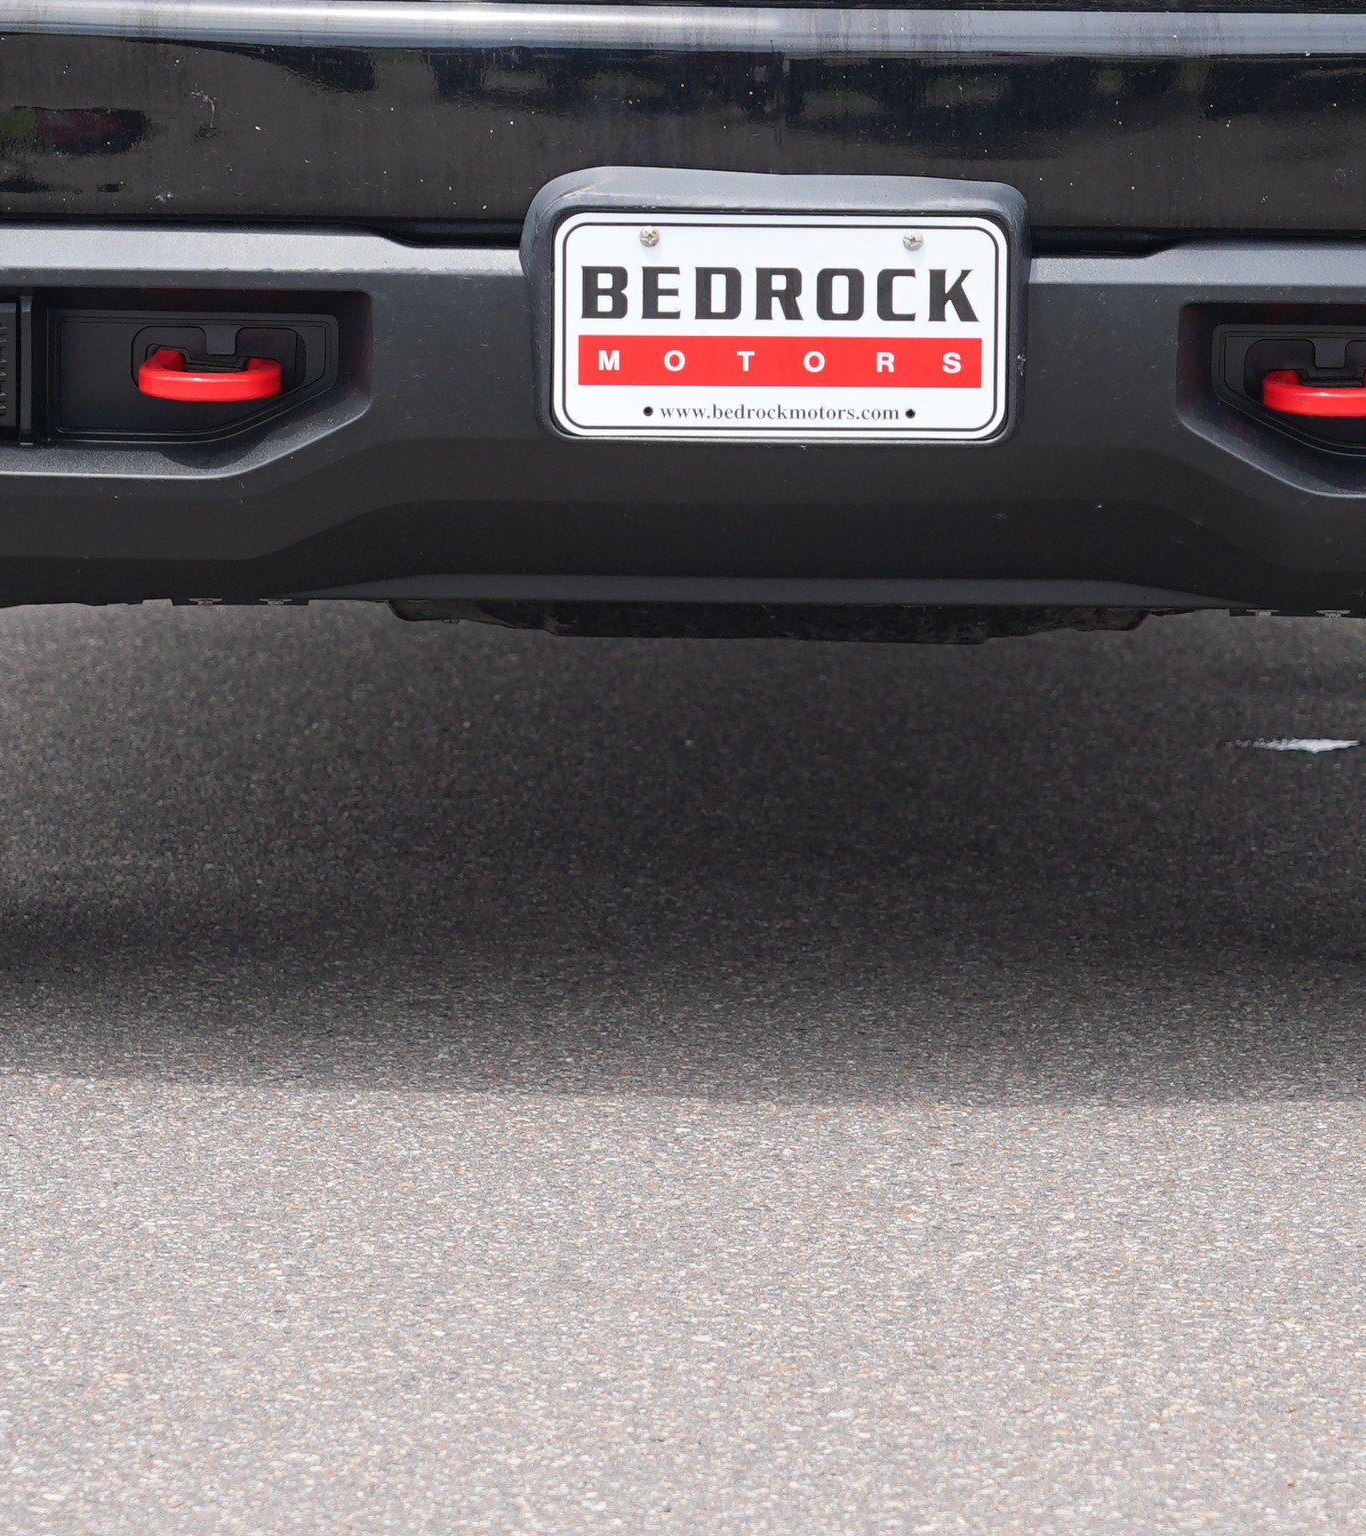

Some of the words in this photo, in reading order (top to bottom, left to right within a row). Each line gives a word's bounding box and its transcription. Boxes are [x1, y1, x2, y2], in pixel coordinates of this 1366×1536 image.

[580, 265, 980, 323] BEDROCK
[598, 349, 962, 374] MOTORS
[659, 403, 901, 422] www.bedrockmotors.com
